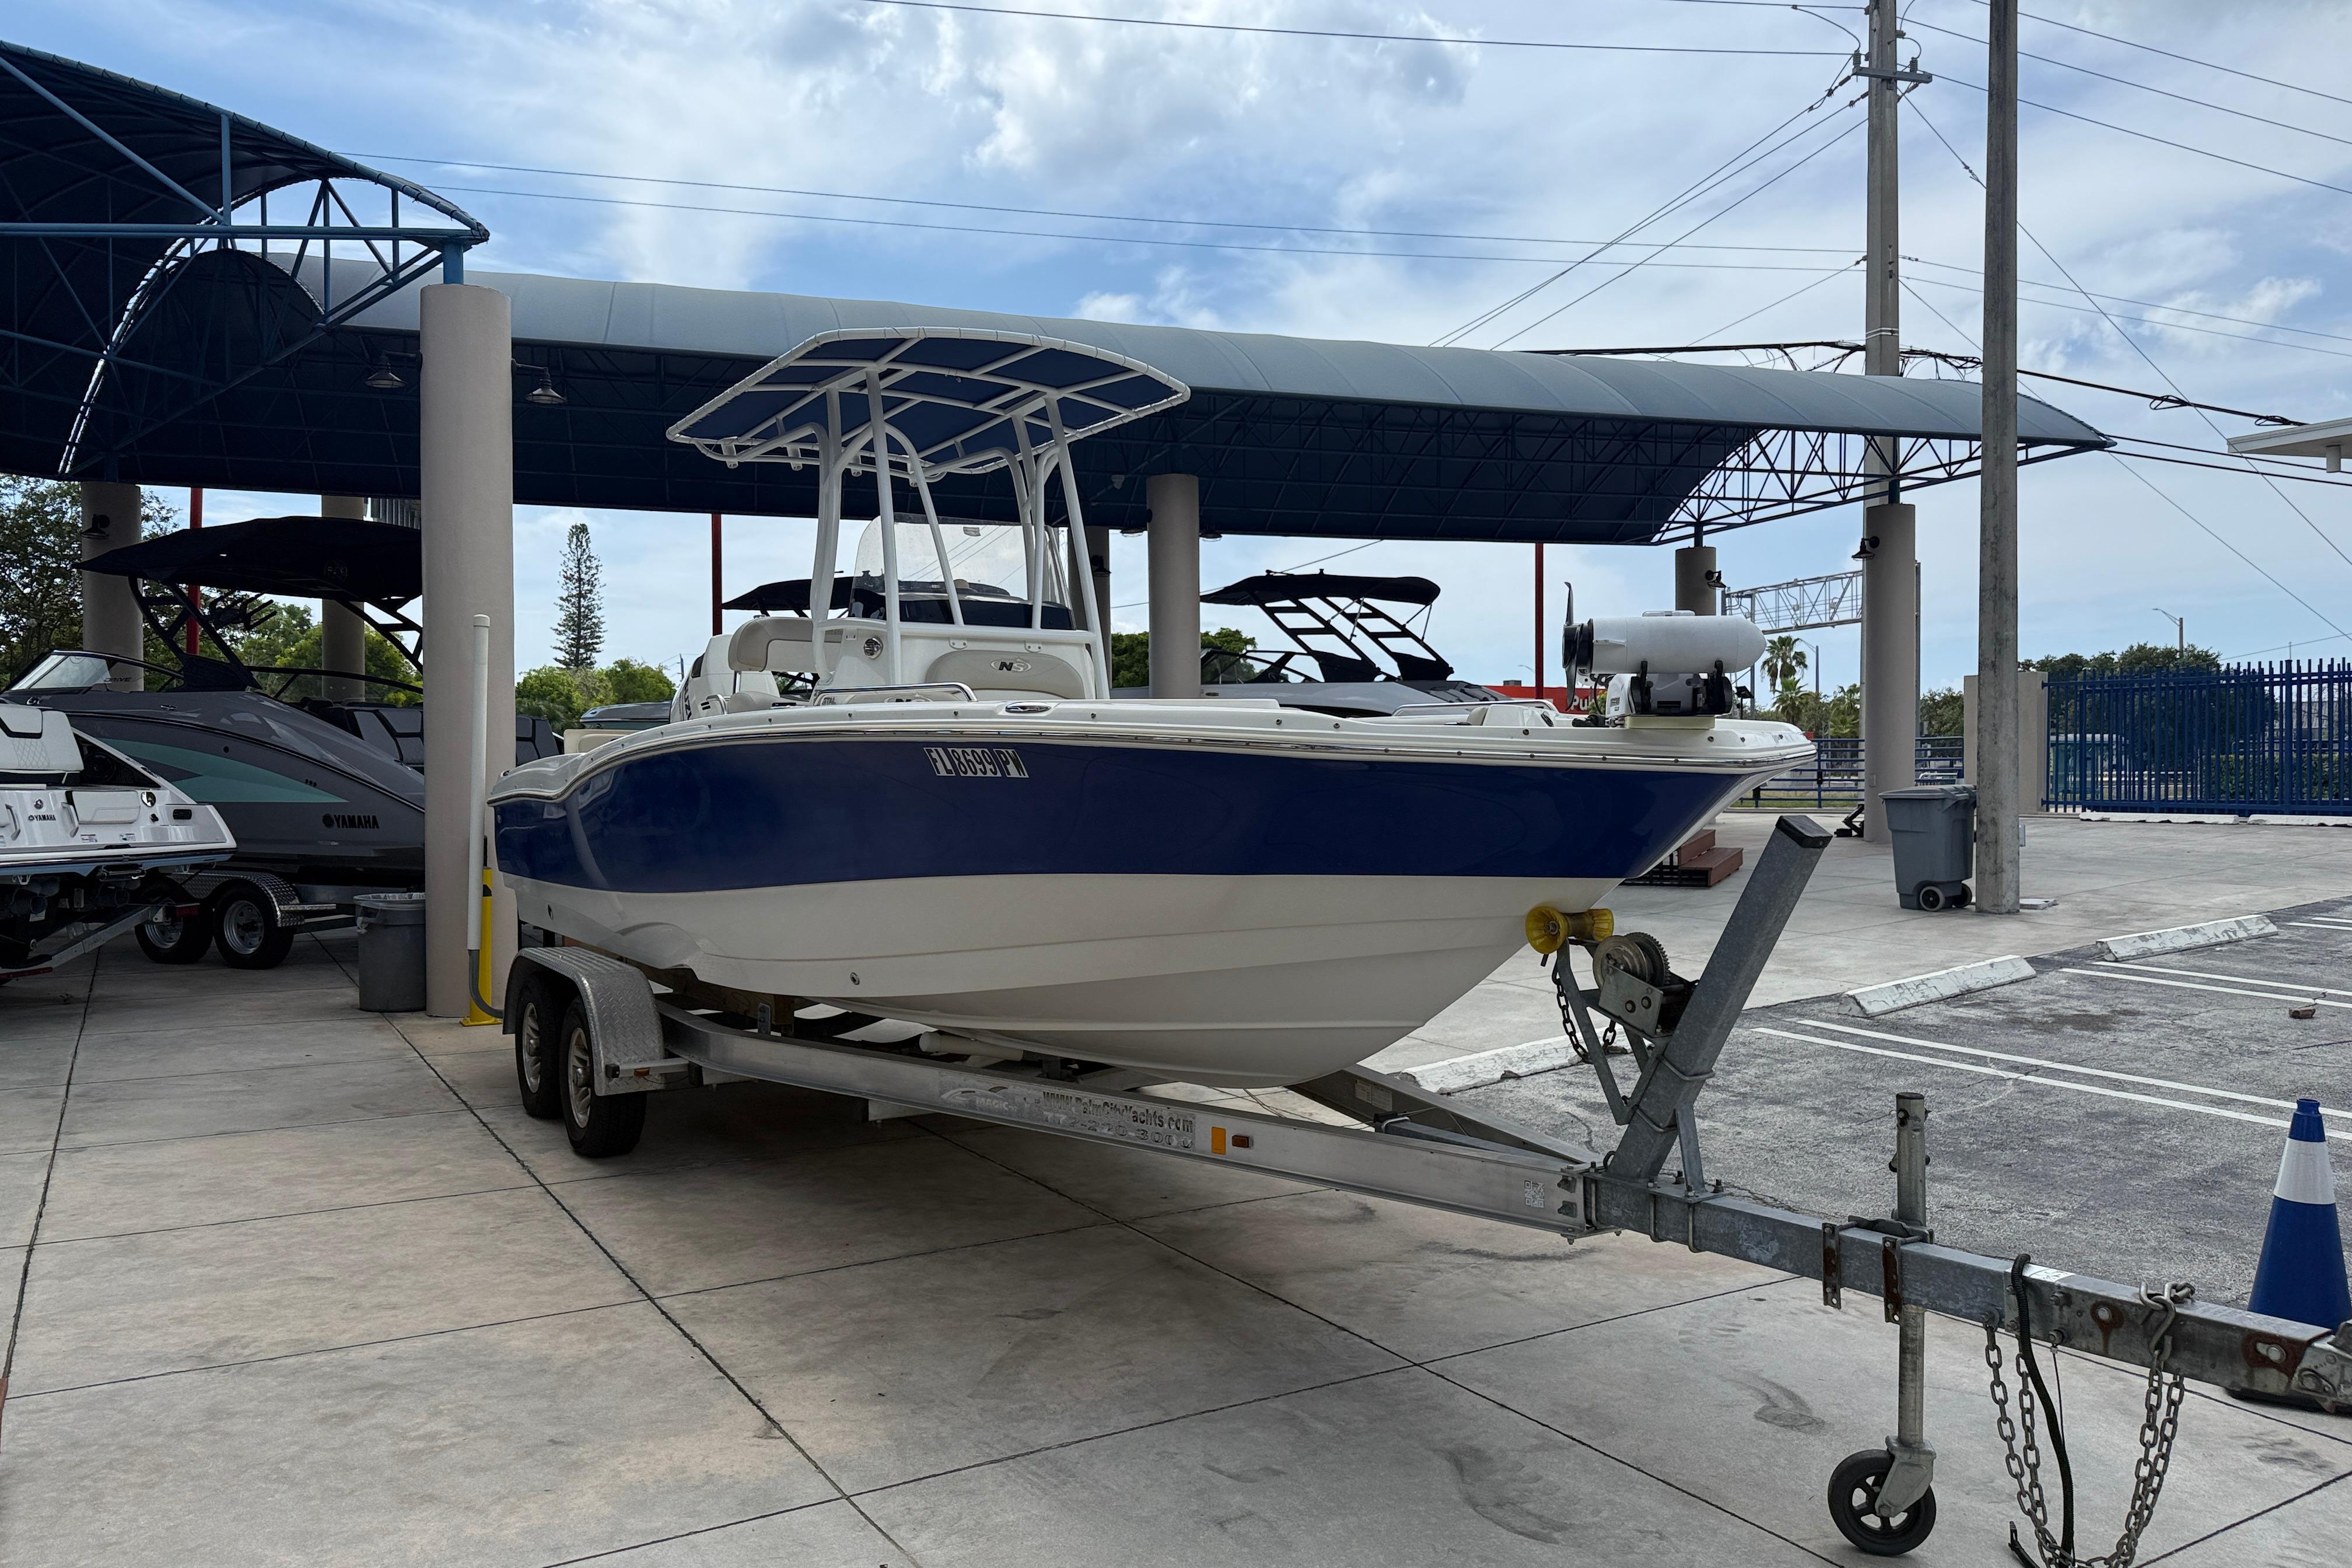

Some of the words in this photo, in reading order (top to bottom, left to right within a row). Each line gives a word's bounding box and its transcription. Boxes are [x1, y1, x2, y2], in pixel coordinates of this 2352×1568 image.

[999, 661, 1025, 672] NS
[925, 748, 953, 775] FL
[951, 749, 998, 776] 8699
[995, 750, 1026, 776] PW
[334, 814, 380, 829] YAMAHA
